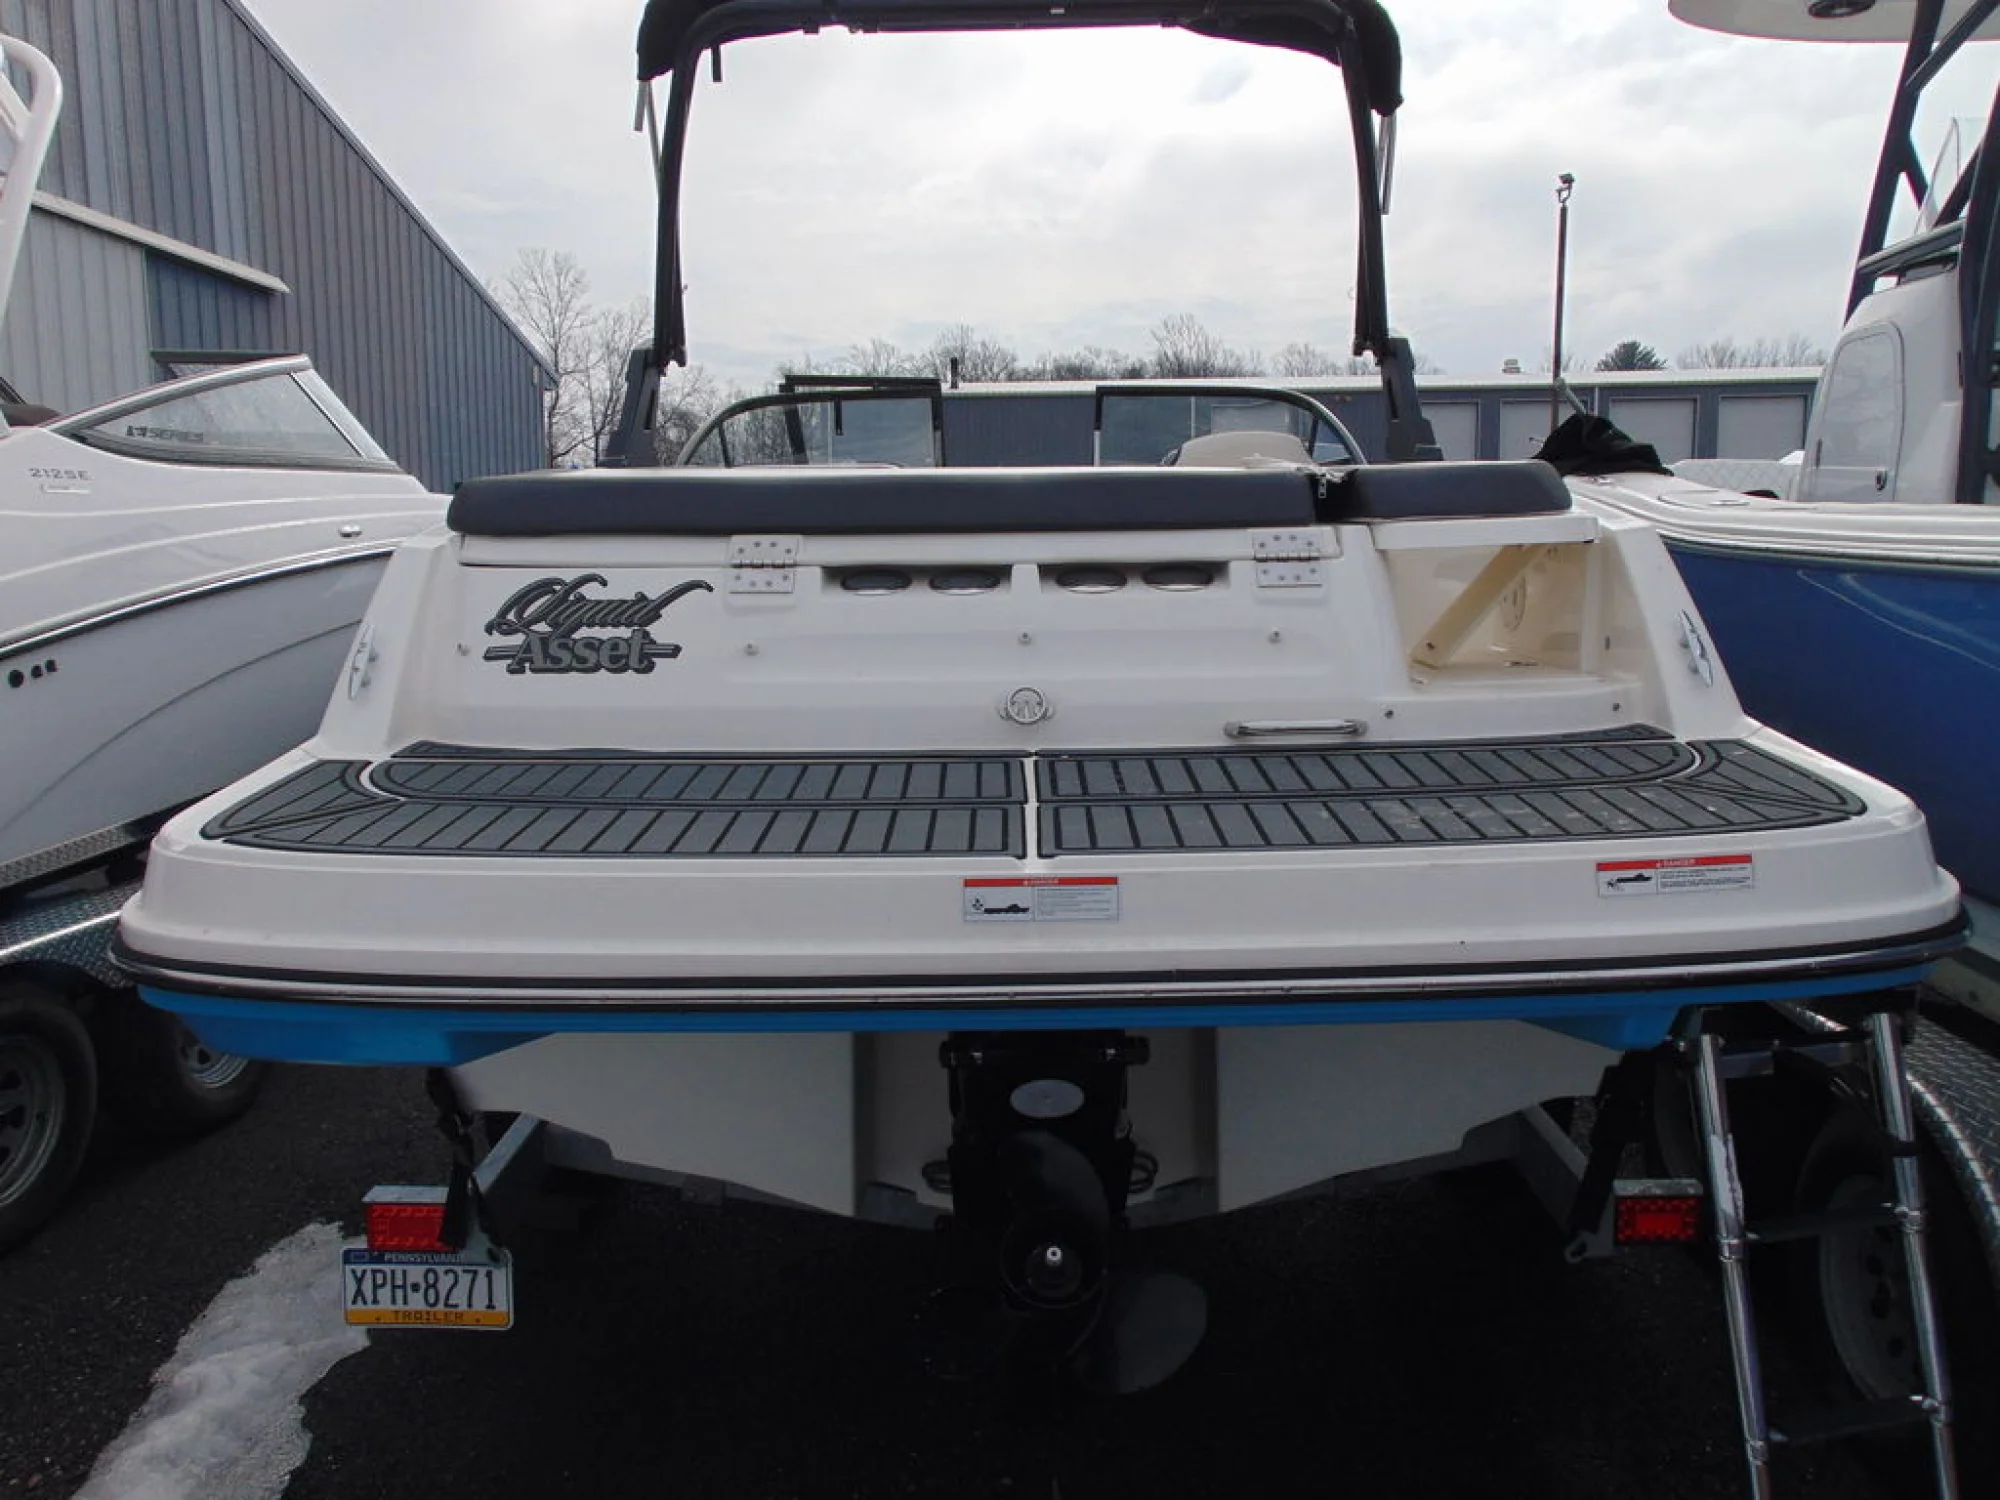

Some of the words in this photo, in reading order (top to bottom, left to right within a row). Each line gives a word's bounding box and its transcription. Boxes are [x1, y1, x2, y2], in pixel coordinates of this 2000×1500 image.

[29, 468, 91, 481] 212SE
[506, 627, 657, 675] Asset
[393, 1310, 464, 1322] TRAILER
